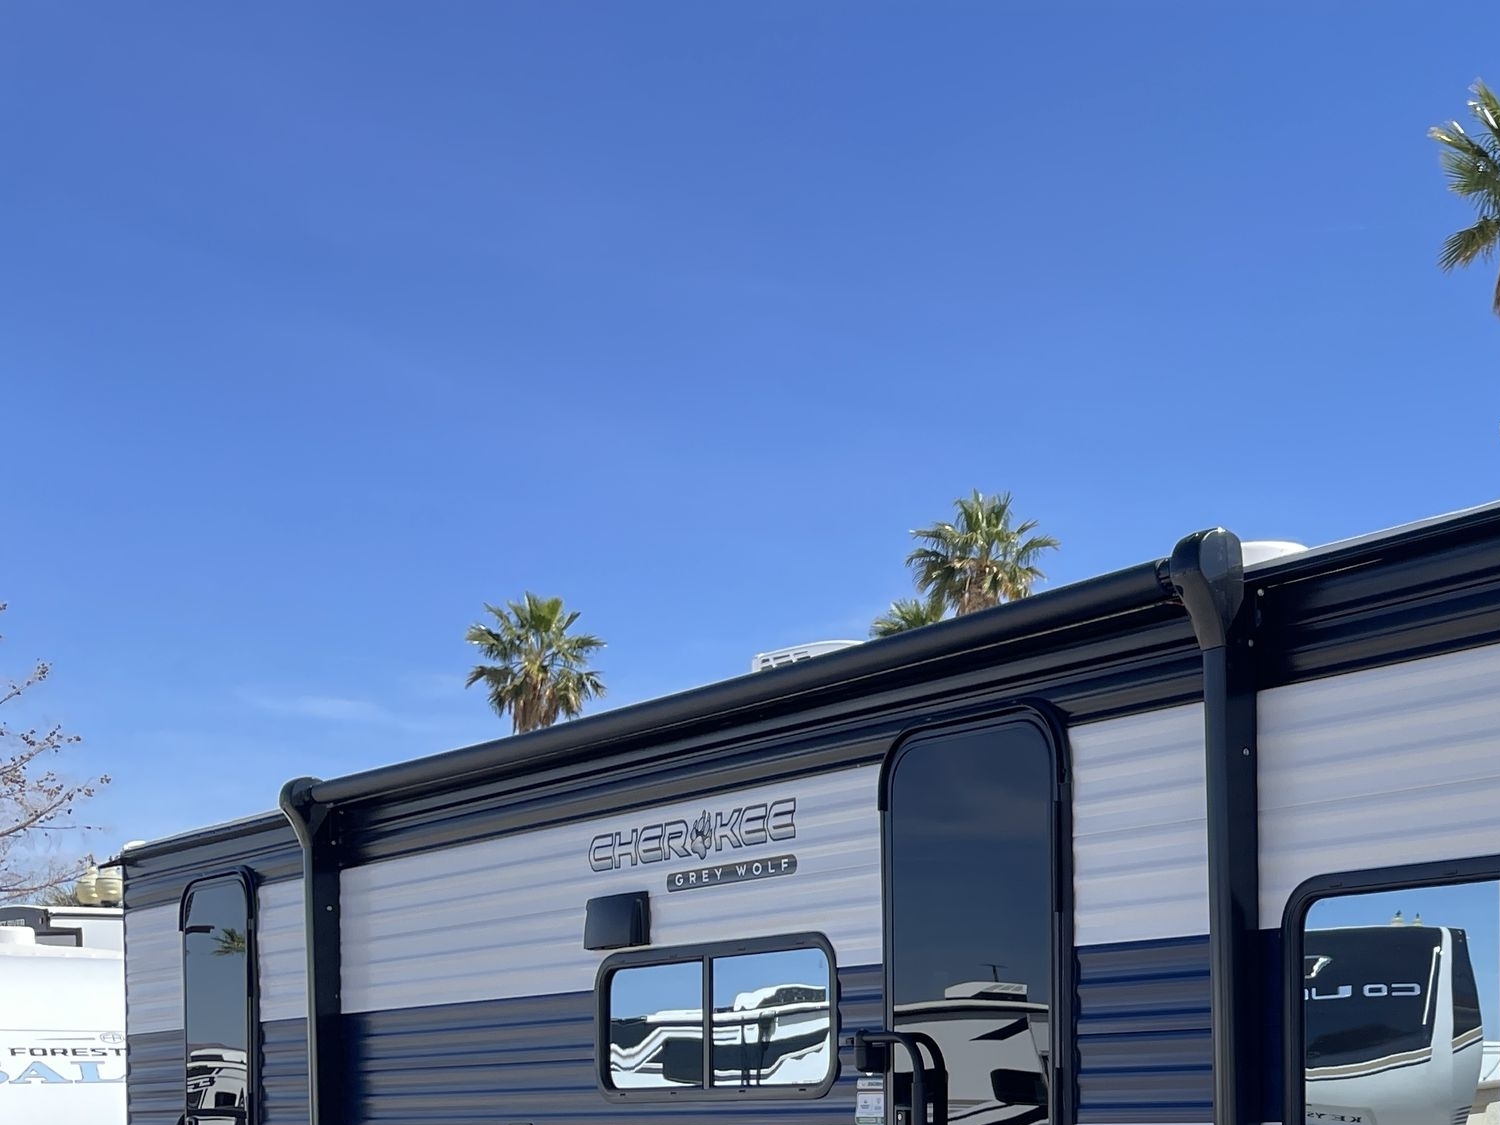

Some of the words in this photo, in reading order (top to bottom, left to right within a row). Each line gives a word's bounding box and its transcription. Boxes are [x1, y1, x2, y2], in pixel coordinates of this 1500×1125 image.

[675, 868, 722, 886] GREY
[735, 858, 789, 877] WOLF
[8, 1047, 126, 1056] FOREST
[0, 1060, 126, 1085] AL
